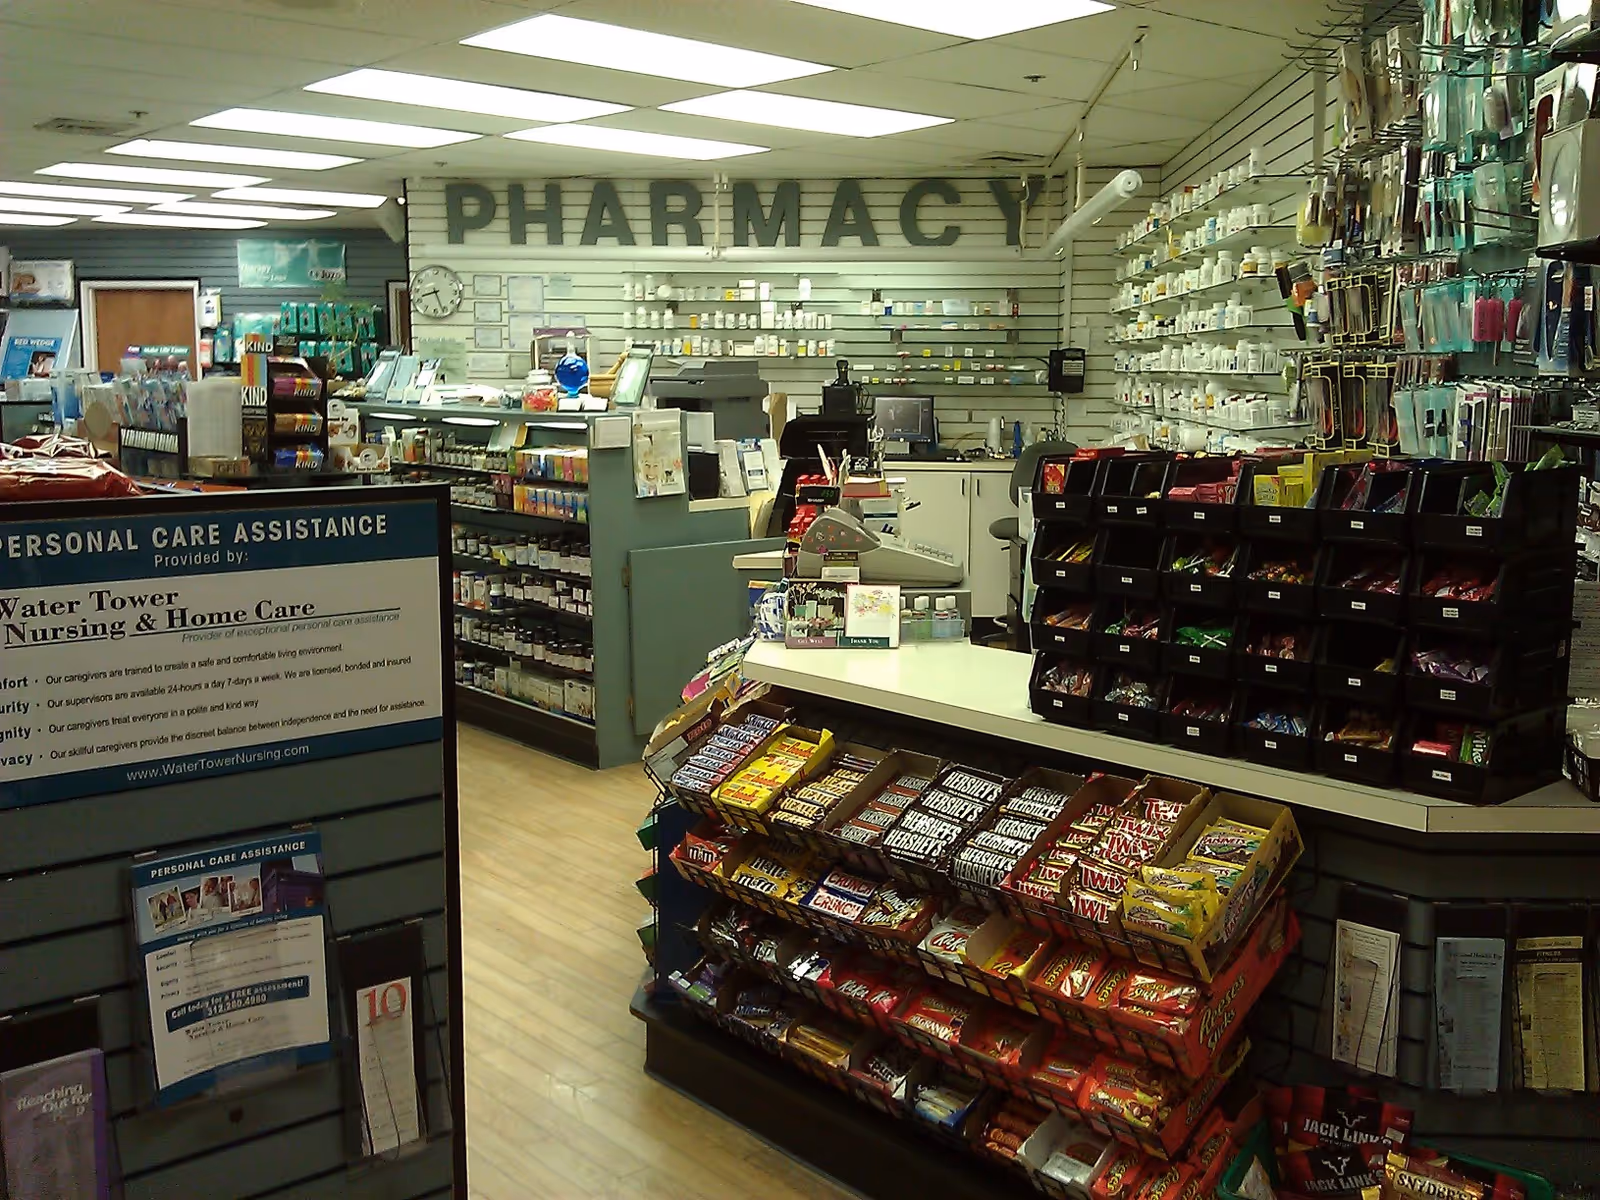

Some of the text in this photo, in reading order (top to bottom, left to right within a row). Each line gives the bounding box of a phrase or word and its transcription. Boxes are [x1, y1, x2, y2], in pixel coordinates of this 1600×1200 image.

[445, 179, 1045, 247] PHARMACY
[245, 341, 273, 353] KIND
[241, 386, 267, 407] KIND
[294, 388, 316, 397] KIND
[295, 424, 317, 433] KIND
[295, 460, 318, 469] KIND
[0, 514, 387, 559] ERSONAL CARE ASSISTANCE
[154, 549, 249, 568] Provided by:
[0, 590, 179, 621] Water Tower
[3, 600, 316, 644] Nursing & Home Care
[182, 612, 400, 643] Provider of exceptional personal care assistance
[46, 674, 62, 685] Our
[64, 668, 107, 684] caregivers
[109, 667, 123, 678] are
[124, 664, 152, 677] trained
[154, 663, 162, 673] to
[164, 660, 189, 672] create
[198, 654, 215, 668] safe
[216, 654, 231, 667] and
[233, 649, 276, 665] comfortable
[277, 646, 297, 660] living
[47, 698, 64, 709] Our
[65, 692, 113, 708] supervisors
[115, 691, 129, 701] are
[130, 686, 166, 699] available
[167, 681, 202, 694] 24-hours
[211, 677, 226, 690] day
[227, 676, 253, 688] 7-days
[284, 670, 297, 680] We
[298, 670, 311, 678] are
[345, 661, 371, 673] bonded
[372, 659, 385, 669] and
[49, 723, 65, 734] Our
[67, 717, 110, 732] caregivers
[112, 713, 131, 725] treat
[132, 710, 169, 723] everyone
[187, 702, 208, 716] polite
[209, 702, 225, 712] and
[226, 700, 242, 711] kind
[243, 700, 259, 710] way
[50, 702, 389, 760] Our skillful caregivers provide the discreet balance between independence and the need for
[126, 742, 310, 781] www.WaterTowerNursing.com
[1472, 730, 1488, 765] Mike
[942, 770, 1003, 803] HERSHEY'S
[780, 797, 818, 818] HEATH
[921, 788, 984, 822] HERSHEY'S
[882, 828, 946, 858] HERSHEY'S
[1118, 814, 1171, 841] TWIX
[151, 840, 306, 879] PERSONAL CARE ASSISTANCE
[1104, 830, 1156, 858] TWIX
[828, 872, 873, 894] CRUNCH
[953, 857, 1005, 887] HERSHEY'S
[1082, 866, 1129, 894] TWIX
[813, 894, 861, 919] CRUNCH
[1070, 890, 1110, 924] TWI
[171, 1007, 187, 1020] Call
[231, 986, 252, 1000] FREE
[253, 978, 304, 995] assessment!
[363, 982, 407, 1026] 10
[1303, 1117, 1393, 1148] JACK LINK'S
[1304, 1168, 1385, 1192] JACK LINK'S
